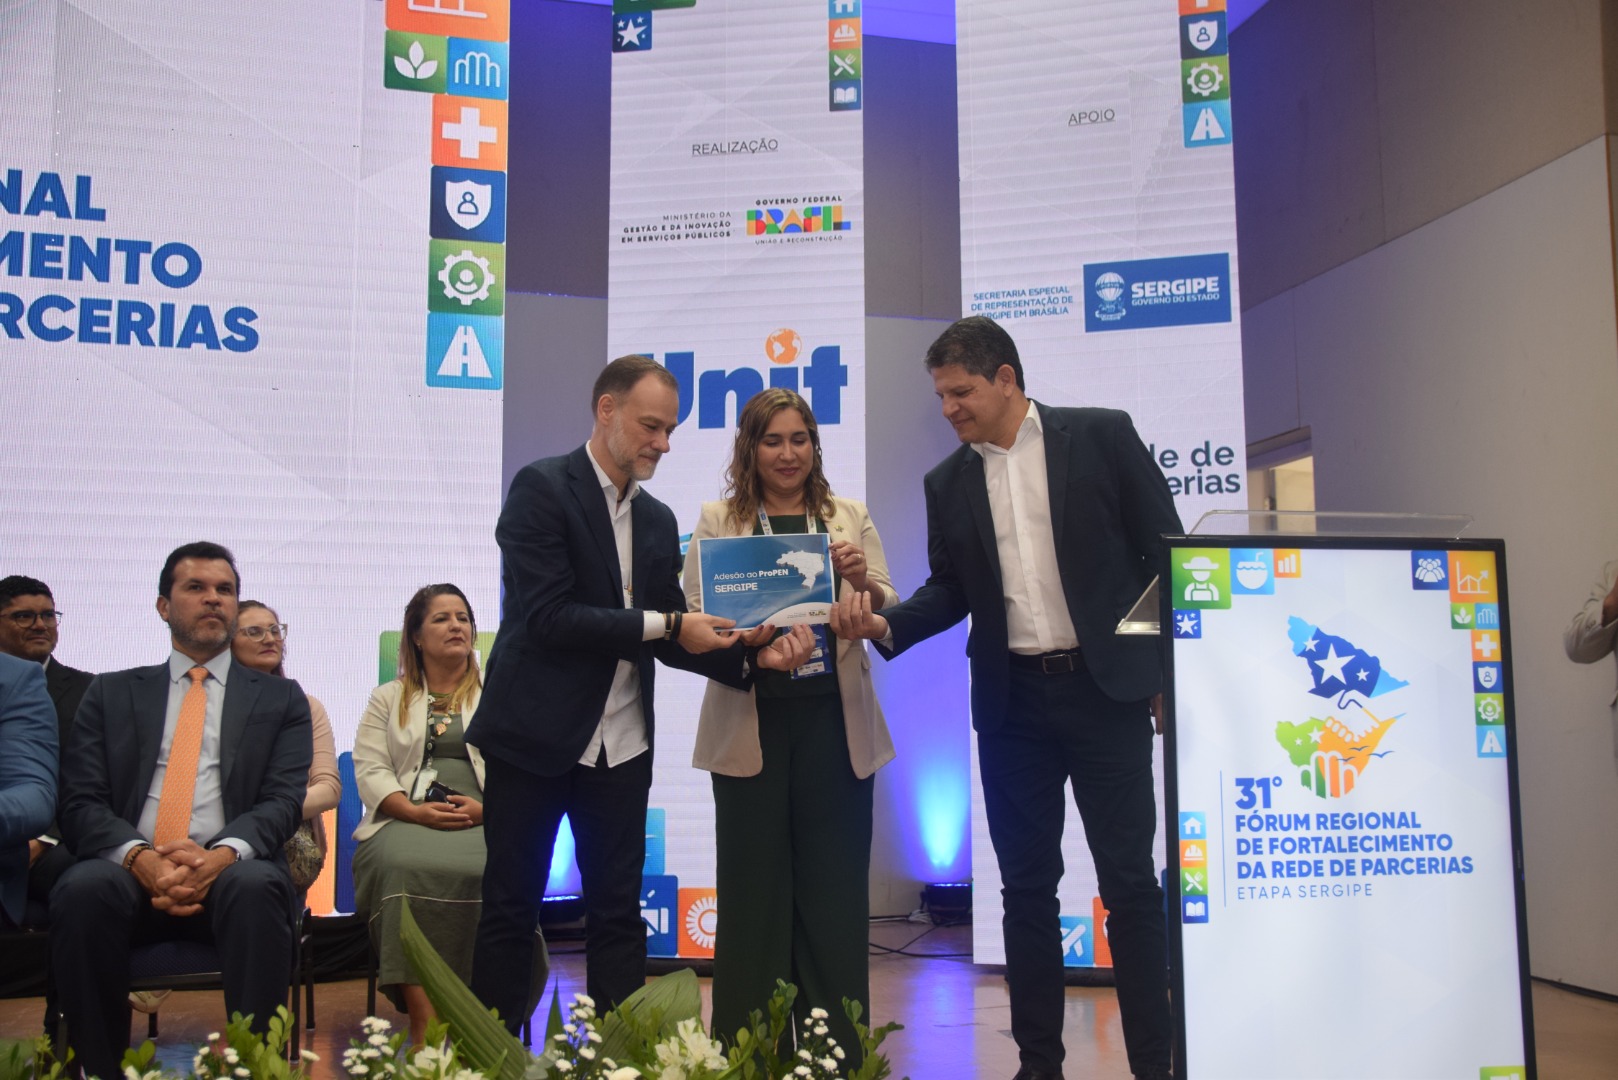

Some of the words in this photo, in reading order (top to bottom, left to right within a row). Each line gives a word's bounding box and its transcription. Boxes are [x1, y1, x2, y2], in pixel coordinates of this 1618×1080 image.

[1068, 108, 1116, 126] APOIO
[692, 138, 779, 157] REALIZAÇÃO
[755, 197, 799, 206] GOVERNO
[802, 195, 843, 203] FEDERAL
[663, 212, 716, 221] MINISTÉRIO
[746, 205, 851, 236] BRASIL
[623, 225, 658, 233] GESTÃO
[685, 220, 731, 229] INOVAÇÃO
[637, 234, 681, 242] SERVIÇOS
[685, 231, 731, 240] PÚBLICOS
[973, 289, 1026, 300] SECRETARIA
[1029, 286, 1070, 296] ESPECIAL
[1131, 276, 1220, 298] SERGIPE
[971, 303, 983, 311] DE
[985, 296, 1059, 310] REPRESENTAÇÃO
[1061, 296, 1073, 304] DE
[1131, 295, 1171, 306] GOVERNO
[1172, 294, 1186, 304] DO
[1186, 292, 1220, 303] ESTADO
[1014, 310, 1027, 318] EM
[1029, 306, 1069, 317] BRASÍLIA
[1190, 440, 1235, 467] de
[713, 572, 745, 581] Adesão
[758, 568, 789, 578] ProPEN
[714, 582, 758, 593] SERGIPE
[1235, 810, 1311, 833] FÓRUM
[1316, 811, 1421, 830] REGIONAL
[1236, 837, 1264, 856] DE
[1269, 833, 1453, 855] FORTALECIMENTO
[1237, 861, 1267, 879] DA
[1272, 859, 1325, 878] REDE
[1330, 858, 1356, 877] DE
[1361, 856, 1474, 876] PARCERIAS
[1237, 885, 1292, 900] ETAPA
[1298, 883, 1373, 898] SERGIPE
